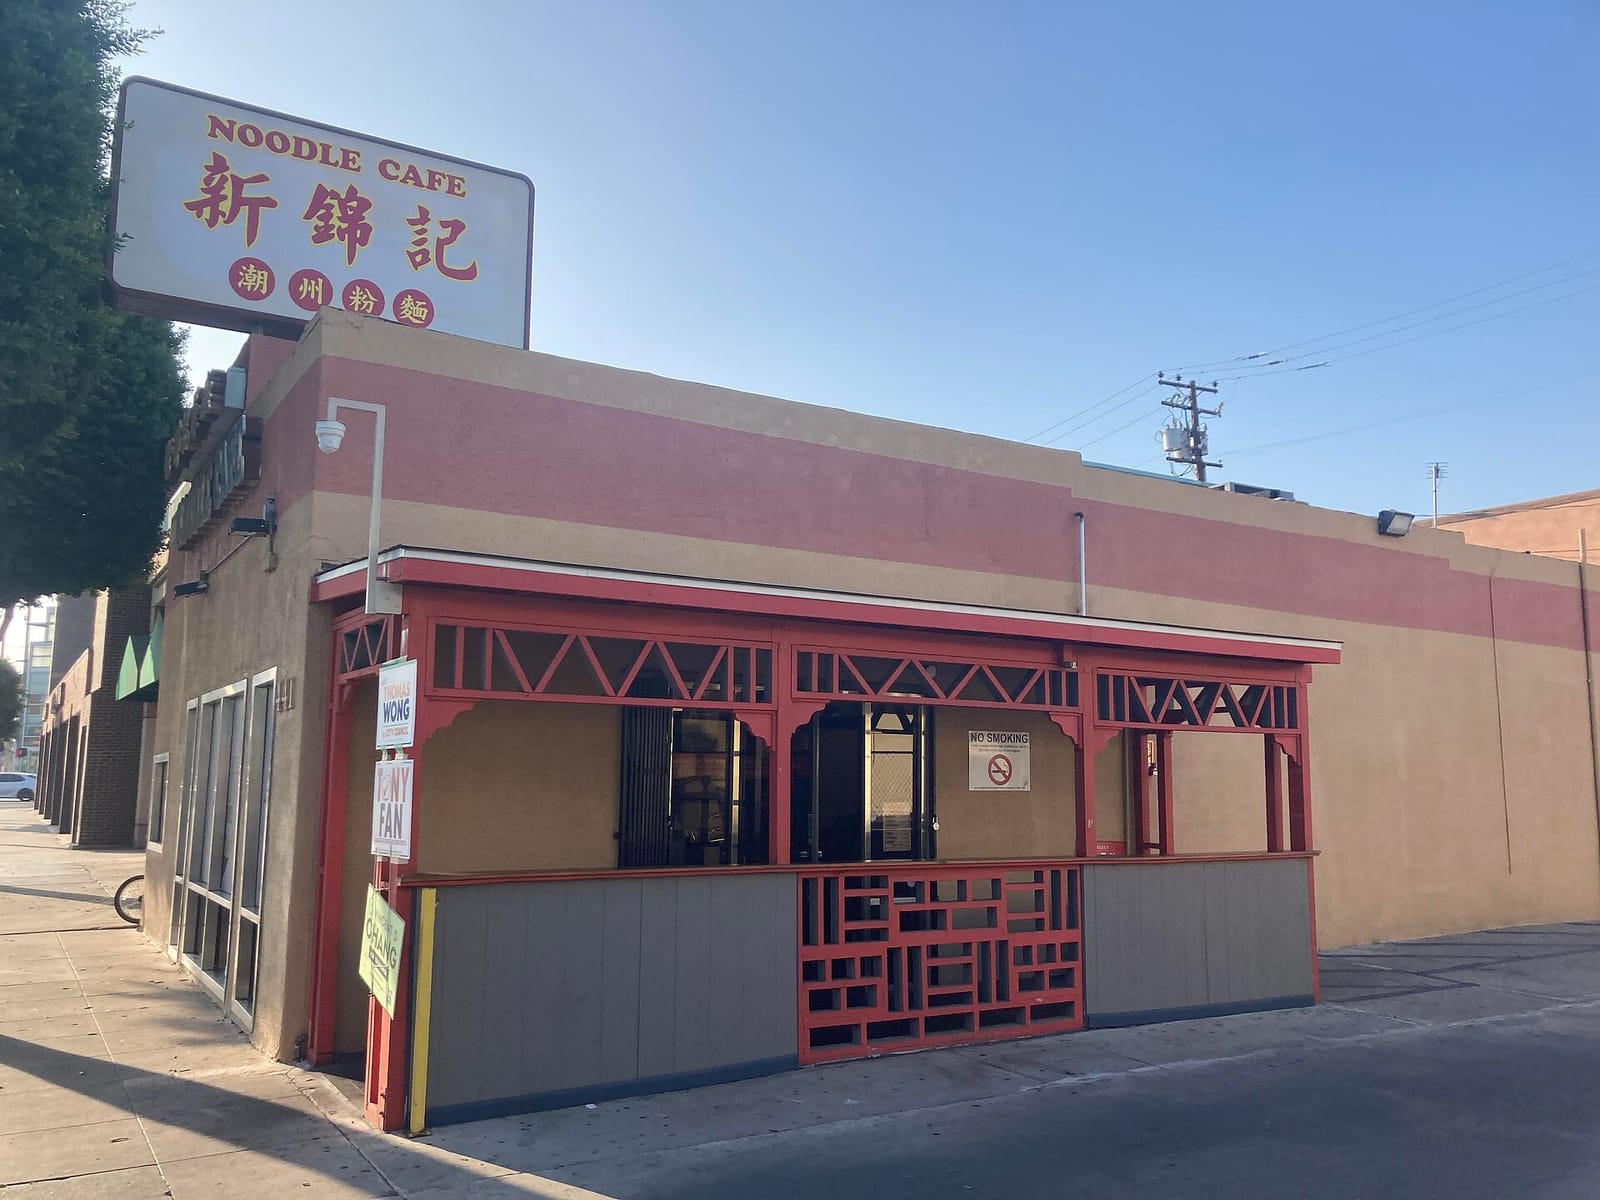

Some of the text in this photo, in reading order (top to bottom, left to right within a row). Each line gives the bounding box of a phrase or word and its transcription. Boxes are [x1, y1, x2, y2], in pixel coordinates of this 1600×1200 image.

[207, 114, 467, 198] NOODLE CAFE
[183, 151, 478, 281] 新錦記
[236, 263, 430, 324] 潮州粉麵
[383, 682, 410, 701] THOMAS
[383, 698, 410, 723] WONG
[970, 733, 1029, 743] NO SMOKING
[379, 803, 403, 839] FAN
[366, 918, 397, 969] CHANG
